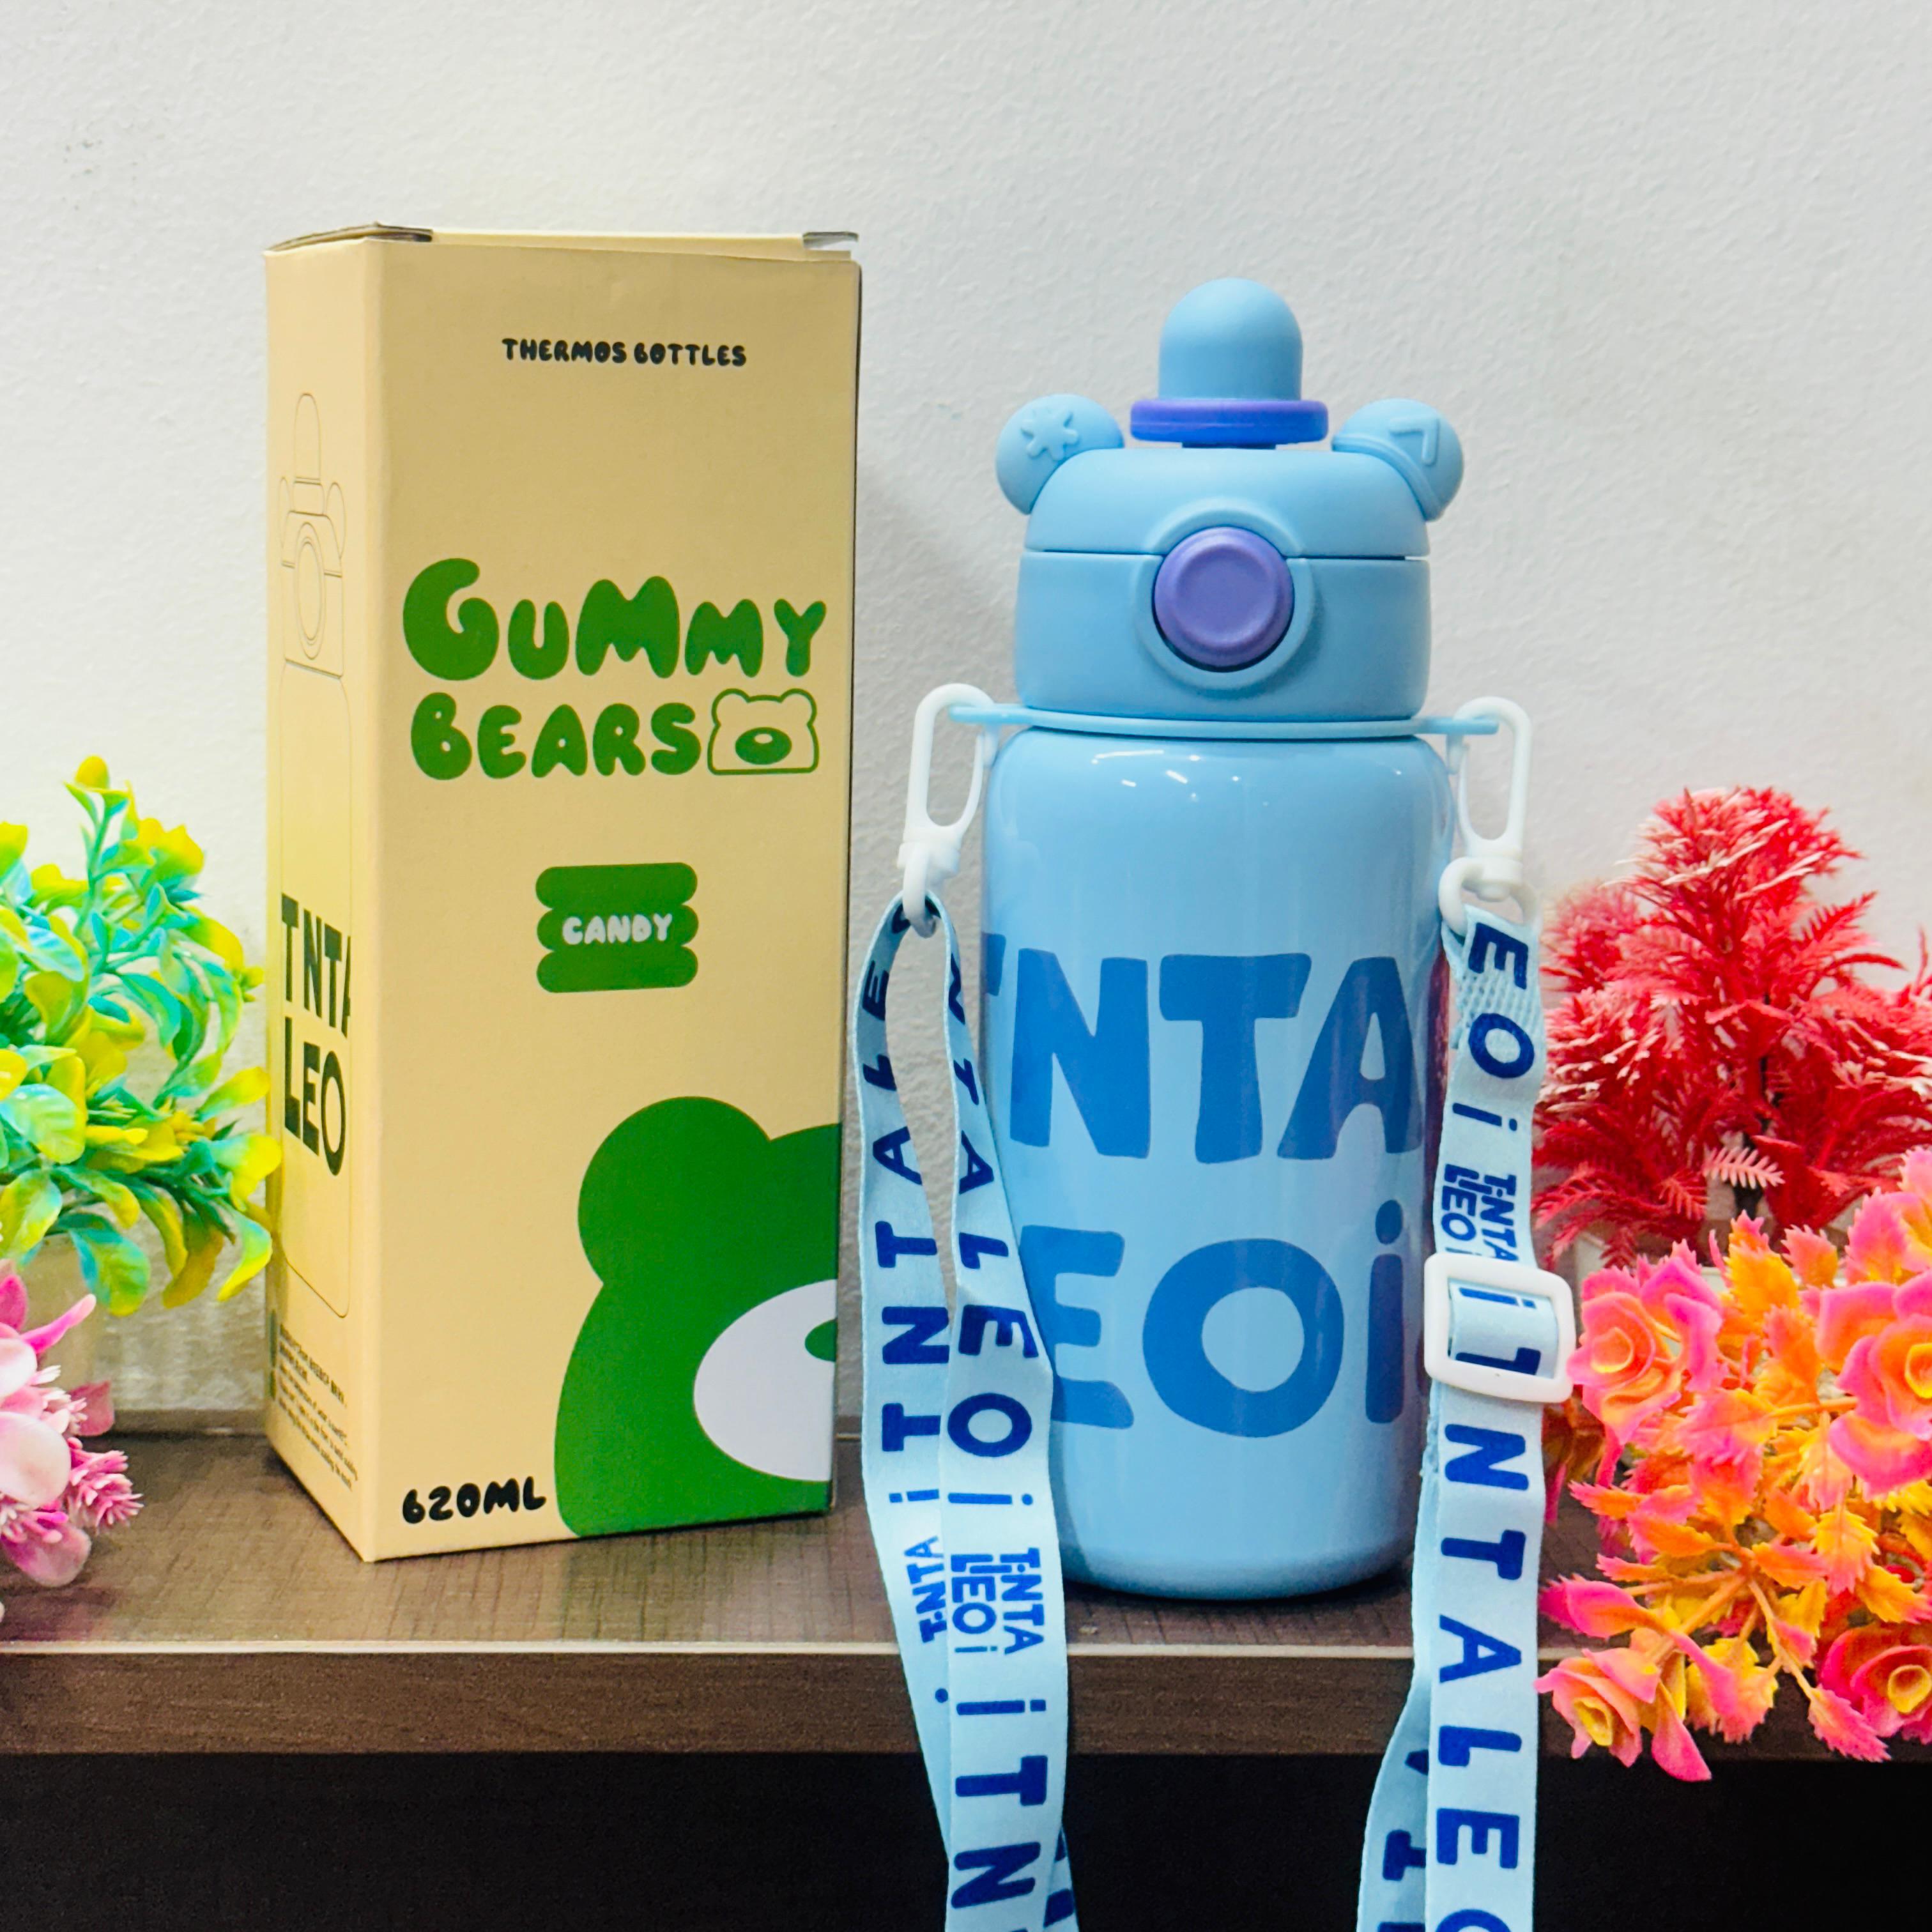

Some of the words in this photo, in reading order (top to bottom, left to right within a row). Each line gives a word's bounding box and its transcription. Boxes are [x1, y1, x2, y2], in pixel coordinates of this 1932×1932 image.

[502, 338, 627, 364] THERMOS
[634, 342, 747, 366] BOTTLES
[411, 693, 701, 780] BEARS
[562, 913, 673, 945] CANDY
[284, 1016, 346, 1176] LEO
[402, 1476, 546, 1524] 620ML
